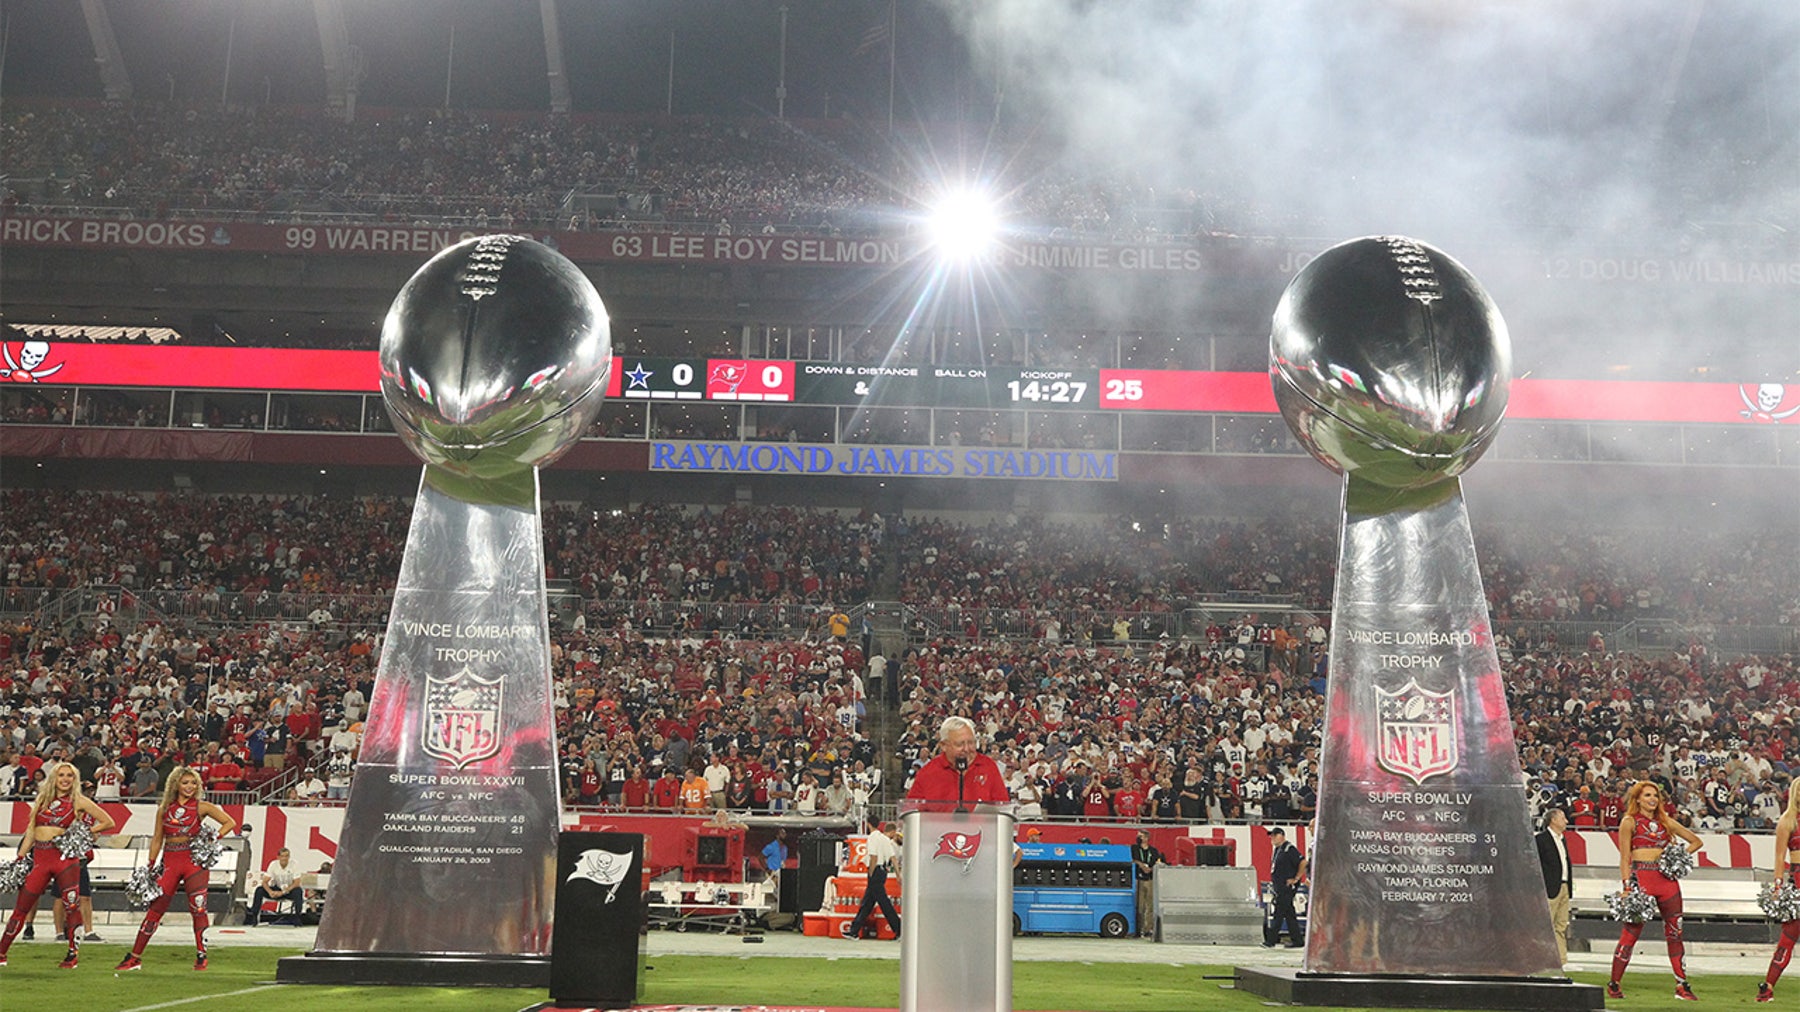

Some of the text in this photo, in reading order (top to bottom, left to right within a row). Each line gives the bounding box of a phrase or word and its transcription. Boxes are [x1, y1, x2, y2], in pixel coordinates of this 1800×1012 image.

[3, 218, 206, 246] RICK BROOKS
[285, 227, 316, 249] 99
[325, 229, 449, 252] WARREN
[611, 236, 899, 264] 63 LEE ROY SELMON
[1013, 245, 1109, 268] JIMMIE
[1118, 249, 1201, 271] GILES
[1578, 258, 1662, 282] DOUG
[1670, 259, 1800, 285] WILLIAMS
[672, 363, 693, 386] 0
[762, 366, 783, 388] 0
[805, 366, 918, 377] DOWN & DISTANCE
[935, 369, 987, 378] BALL ON
[1020, 371, 1073, 380] KICKOFF
[854, 381, 870, 396] &
[1007, 380, 1087, 403] 14:27
[1106, 379, 1143, 401] 25
[651, 443, 1118, 479] RAYMOND JAMES STADIUM
[403, 622, 537, 639] VINCE LOMBARDI
[1349, 630, 1477, 646] VINCE LOMBARDI
[435, 647, 502, 663] TROPHY
[1380, 654, 1443, 669] TROPHY
[232, 723, 245, 734] 12
[430, 712, 492, 754] NFL
[1386, 724, 1449, 769] NFL
[1647, 734, 1660, 746] 12
[1229, 751, 1242, 761] 21
[611, 768, 626, 781] 21
[1680, 765, 1693, 776] 21
[100, 772, 116, 786] 12
[389, 773, 525, 786] SUPER BOWL XXXVII
[585, 774, 597, 785] 12
[420, 790, 445, 800] AFC
[468, 791, 494, 801] NFC
[685, 789, 701, 803] 42
[1089, 792, 1102, 804] 12
[1368, 791, 1472, 805] SUPER BOWL LV
[1763, 797, 1774, 808] 11
[383, 812, 525, 824] TAMPA BAY BUCCANEERS 48
[1382, 810, 1461, 822] AFC vs NFC
[1605, 805, 1618, 818] 12
[382, 823, 523, 834] OAKLAND RAIDERS 21
[1350, 830, 1496, 844] TAMPA BAY BUCCANEERS 31
[379, 844, 523, 855] QUALCOMM STADIUM, SAN DIEGO
[855, 843, 868, 856] G
[1350, 843, 1498, 857] KANSAS CITY CHIEFS 9
[412, 856, 453, 864] JANUARY
[1357, 862, 1494, 875] RAYMOND JAMES STADIUM
[1384, 877, 1468, 888] TAMPA, FLORIDA
[1381, 891, 1437, 902] FEBRUARY
[1450, 893, 1473, 902] 2021
